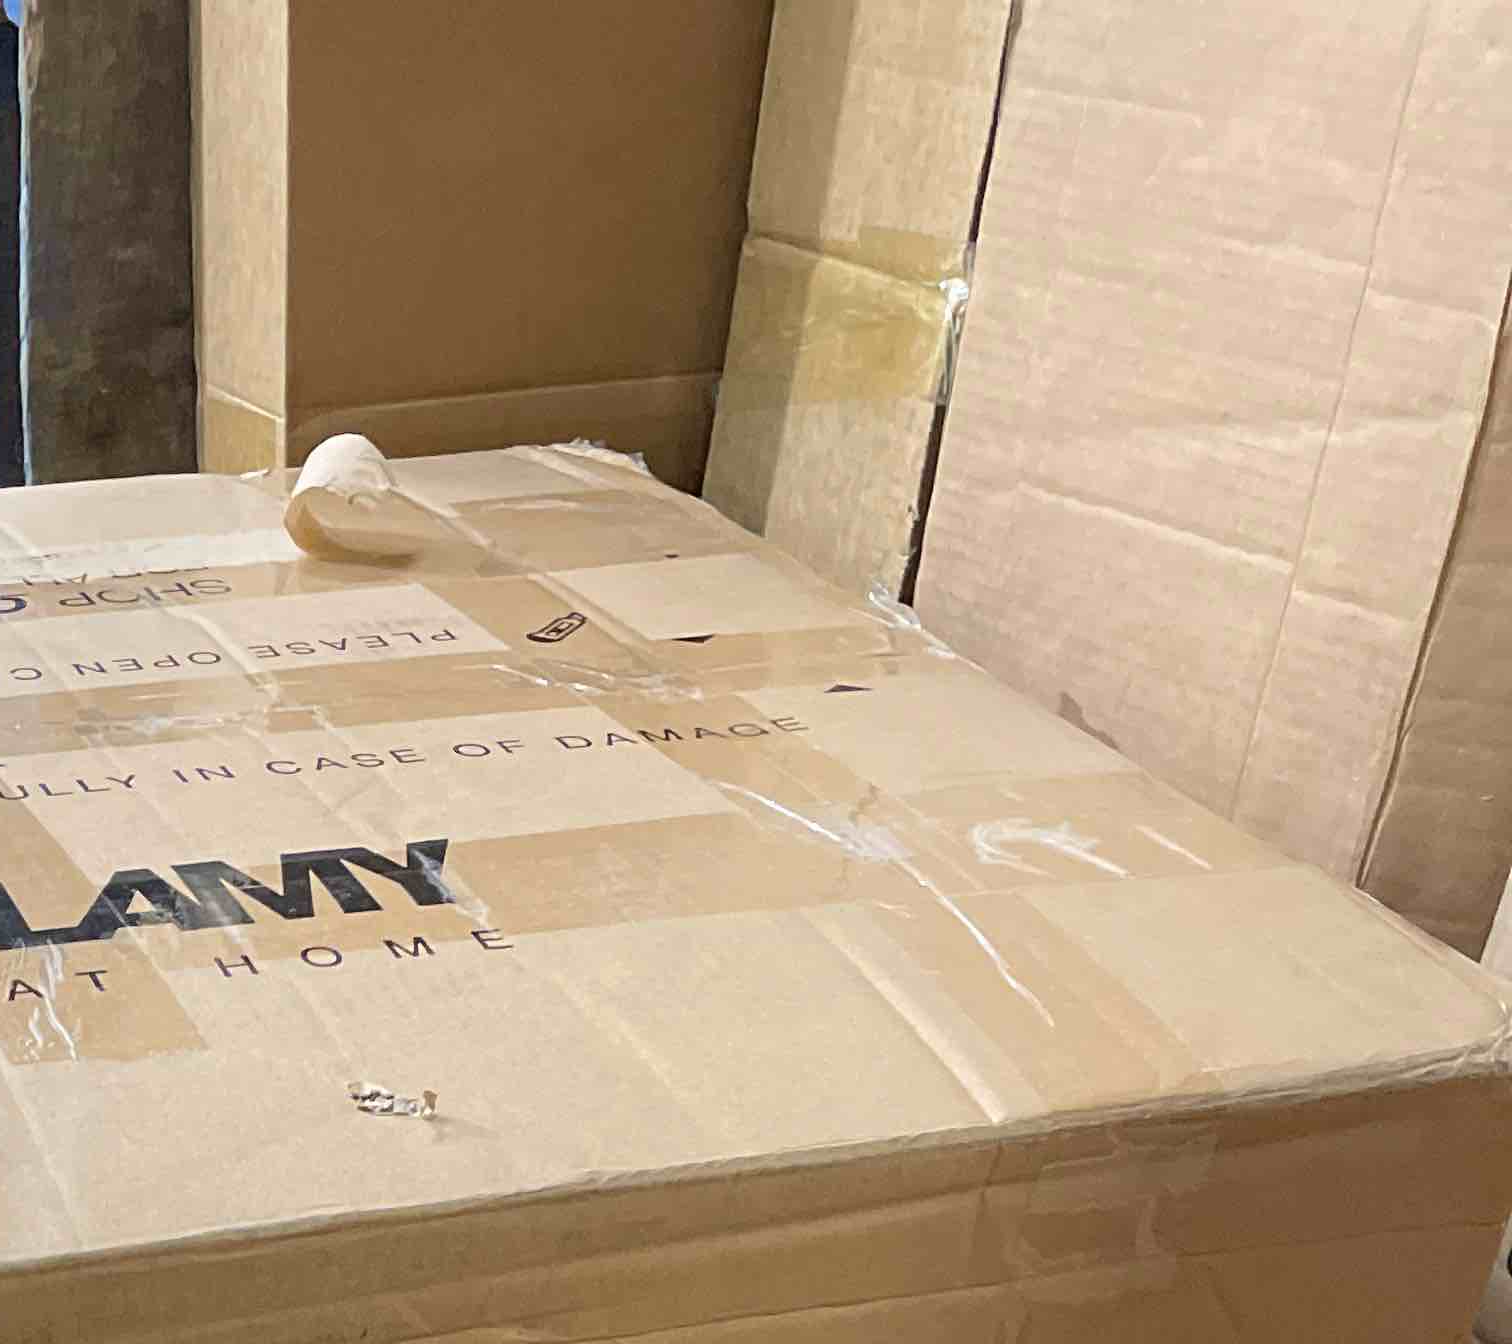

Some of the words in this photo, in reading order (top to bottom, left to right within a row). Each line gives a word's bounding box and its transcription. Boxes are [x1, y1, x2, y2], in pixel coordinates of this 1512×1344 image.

[59, 578, 233, 606] SHOP
[248, 628, 458, 660] PLEASE
[74, 650, 222, 677] OPEN
[172, 765, 237, 784] IN
[264, 748, 427, 777] CASE
[452, 738, 526, 758] OF
[555, 715, 810, 753] DAMAGE
[7, 969, 109, 1003] AT
[214, 927, 514, 979] HOME
